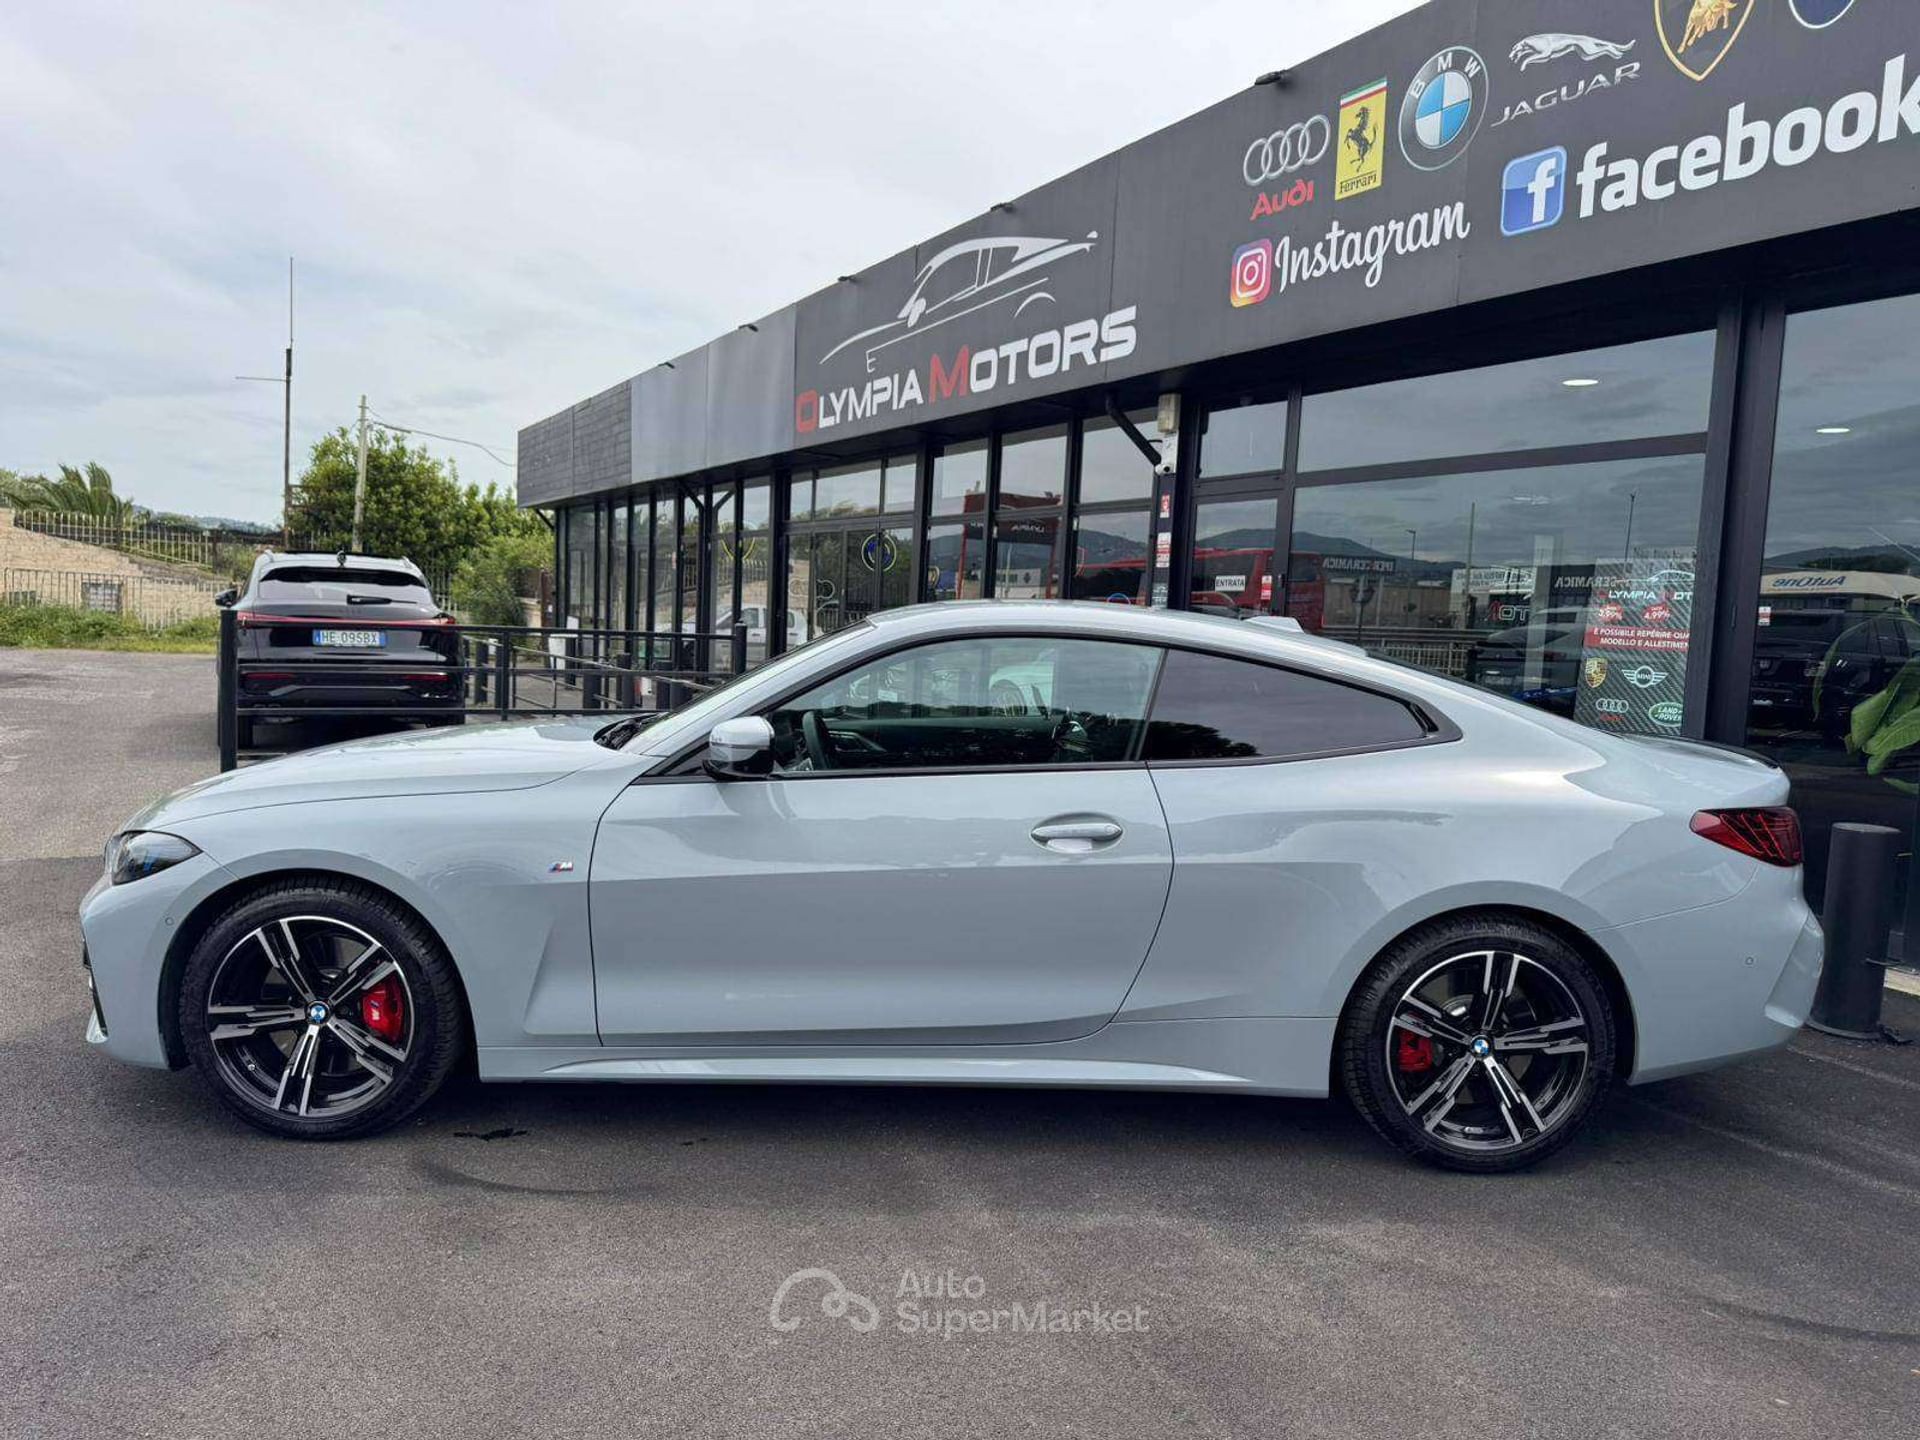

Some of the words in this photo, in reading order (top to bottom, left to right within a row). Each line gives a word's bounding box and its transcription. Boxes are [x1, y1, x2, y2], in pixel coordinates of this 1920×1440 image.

[1409, 52, 1480, 99] BMW
[1491, 62, 1640, 127] JAGUAR
[1576, 54, 1920, 218] facebook
[1250, 180, 1314, 221] Audi
[1339, 174, 1378, 194] Ferrari
[1275, 202, 1470, 292] Instagram
[795, 369, 924, 433] OLYMPIA
[929, 305, 1138, 404] MOTORS
[1215, 576, 1245, 587] ENTRATA
[1600, 629, 1635, 637] POSSIBILE
[1600, 638, 1637, 646] MODELLO
[1658, 706, 1677, 714] LAND
